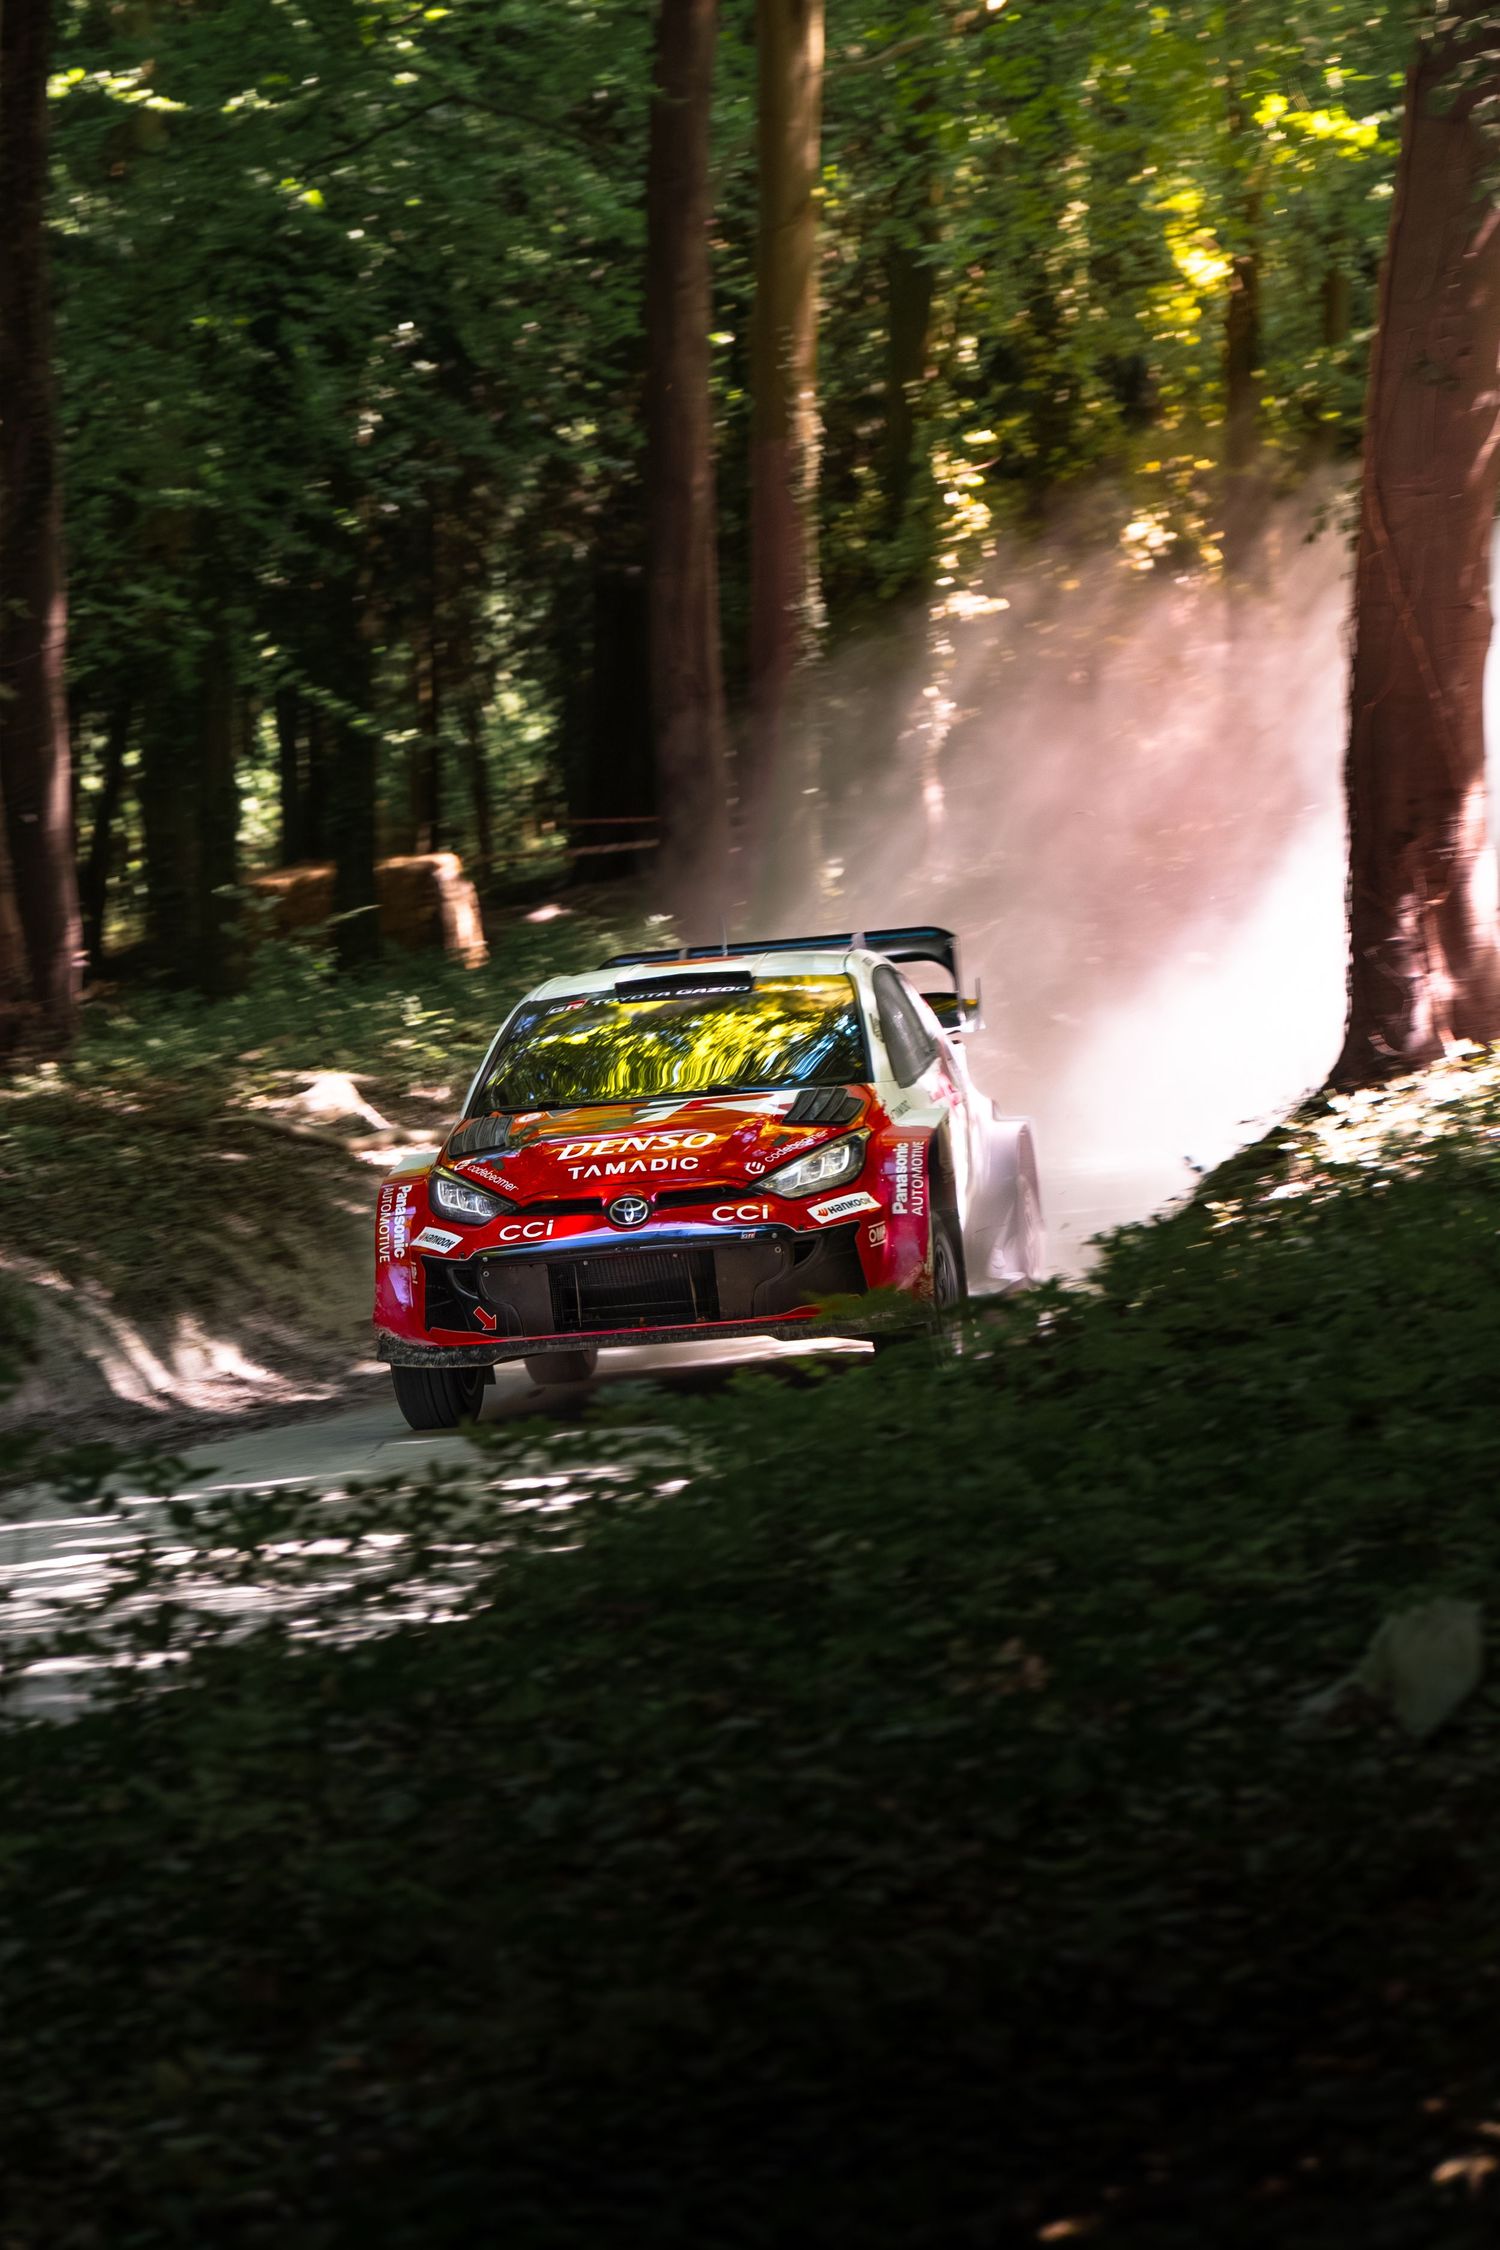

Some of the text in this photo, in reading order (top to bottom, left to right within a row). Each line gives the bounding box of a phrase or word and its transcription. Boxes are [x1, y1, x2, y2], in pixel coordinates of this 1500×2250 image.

[591, 991, 671, 1006] TOYOTA
[675, 985, 750, 996] GAZOO
[557, 1132, 717, 1161] DENSO
[765, 1128, 829, 1162] codebeamer
[467, 1165, 519, 1191] codebeamer
[568, 1157, 699, 1180] TAMADIC
[892, 1142, 909, 1215] Panasonic
[911, 1141, 925, 1216] AUTOMOTIVE
[379, 1186, 394, 1263] AUTOMOTIVE
[394, 1184, 412, 1259] Panasonic
